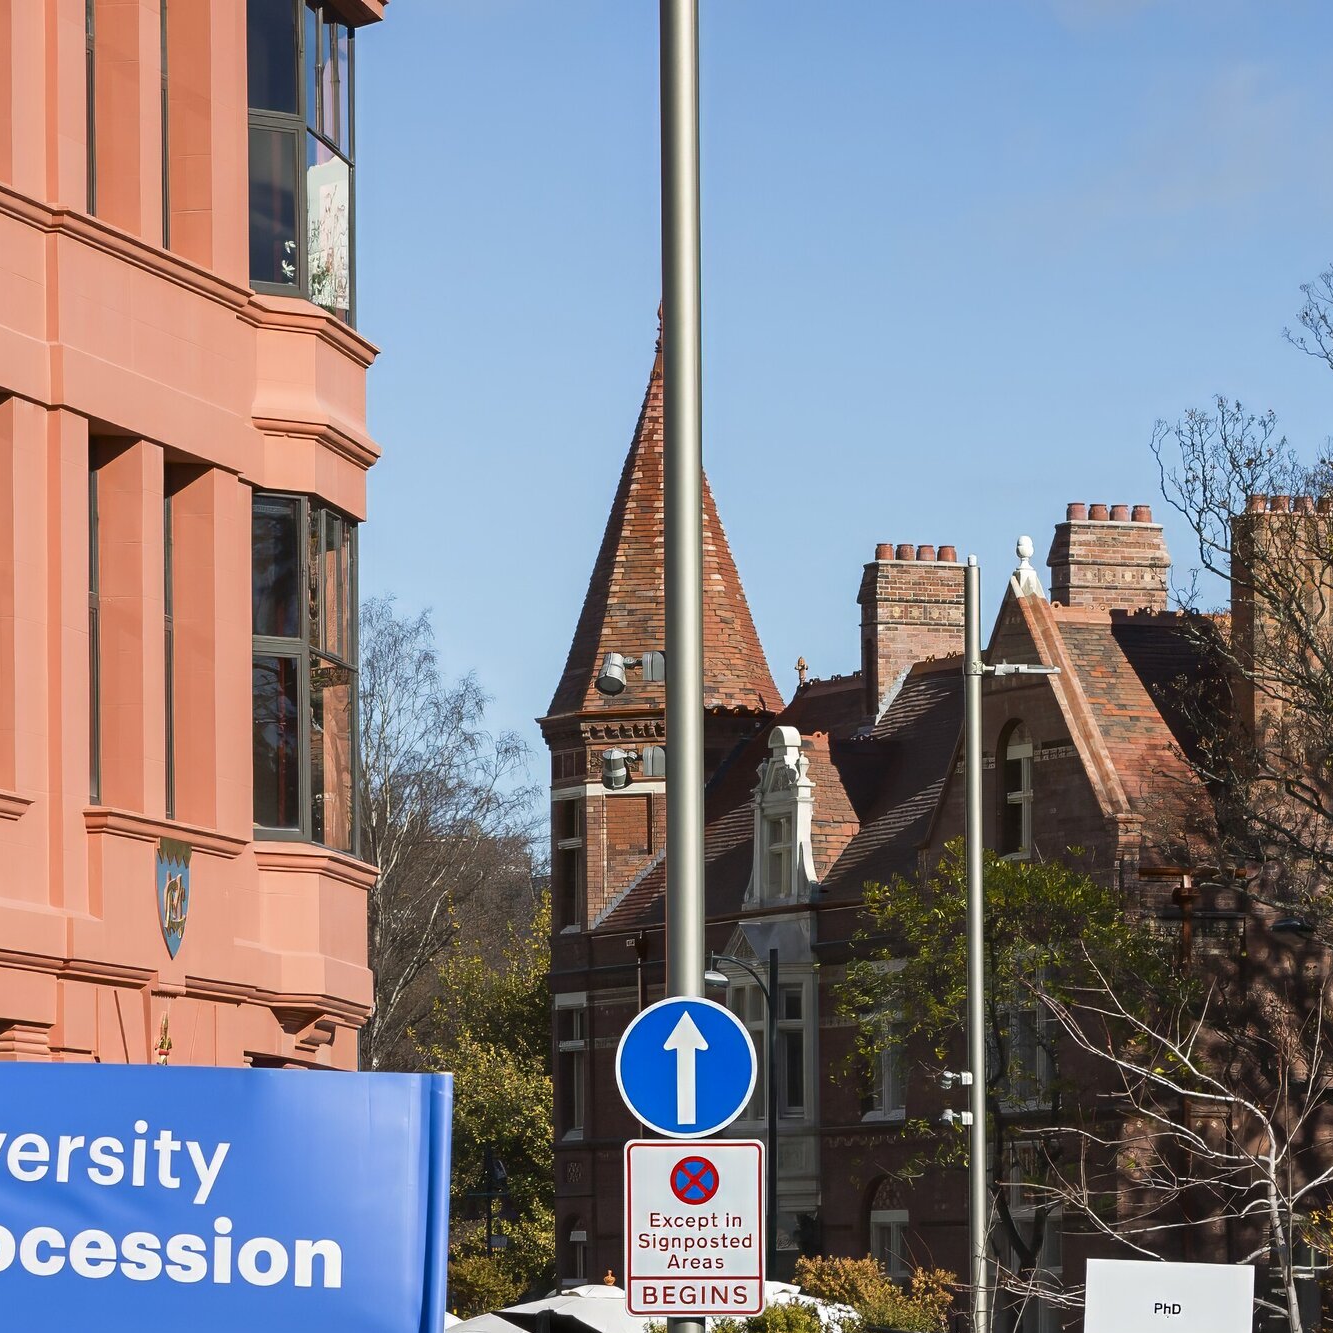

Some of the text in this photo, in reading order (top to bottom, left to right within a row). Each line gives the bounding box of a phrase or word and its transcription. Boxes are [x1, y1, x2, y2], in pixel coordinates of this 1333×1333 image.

[649, 1212, 742, 1231] Except in
[638, 1233, 753, 1252] Signposted
[667, 1254, 725, 1270] Areas
[642, 1285, 748, 1305] BEGINS
[1153, 1302, 1182, 1316] PhD
